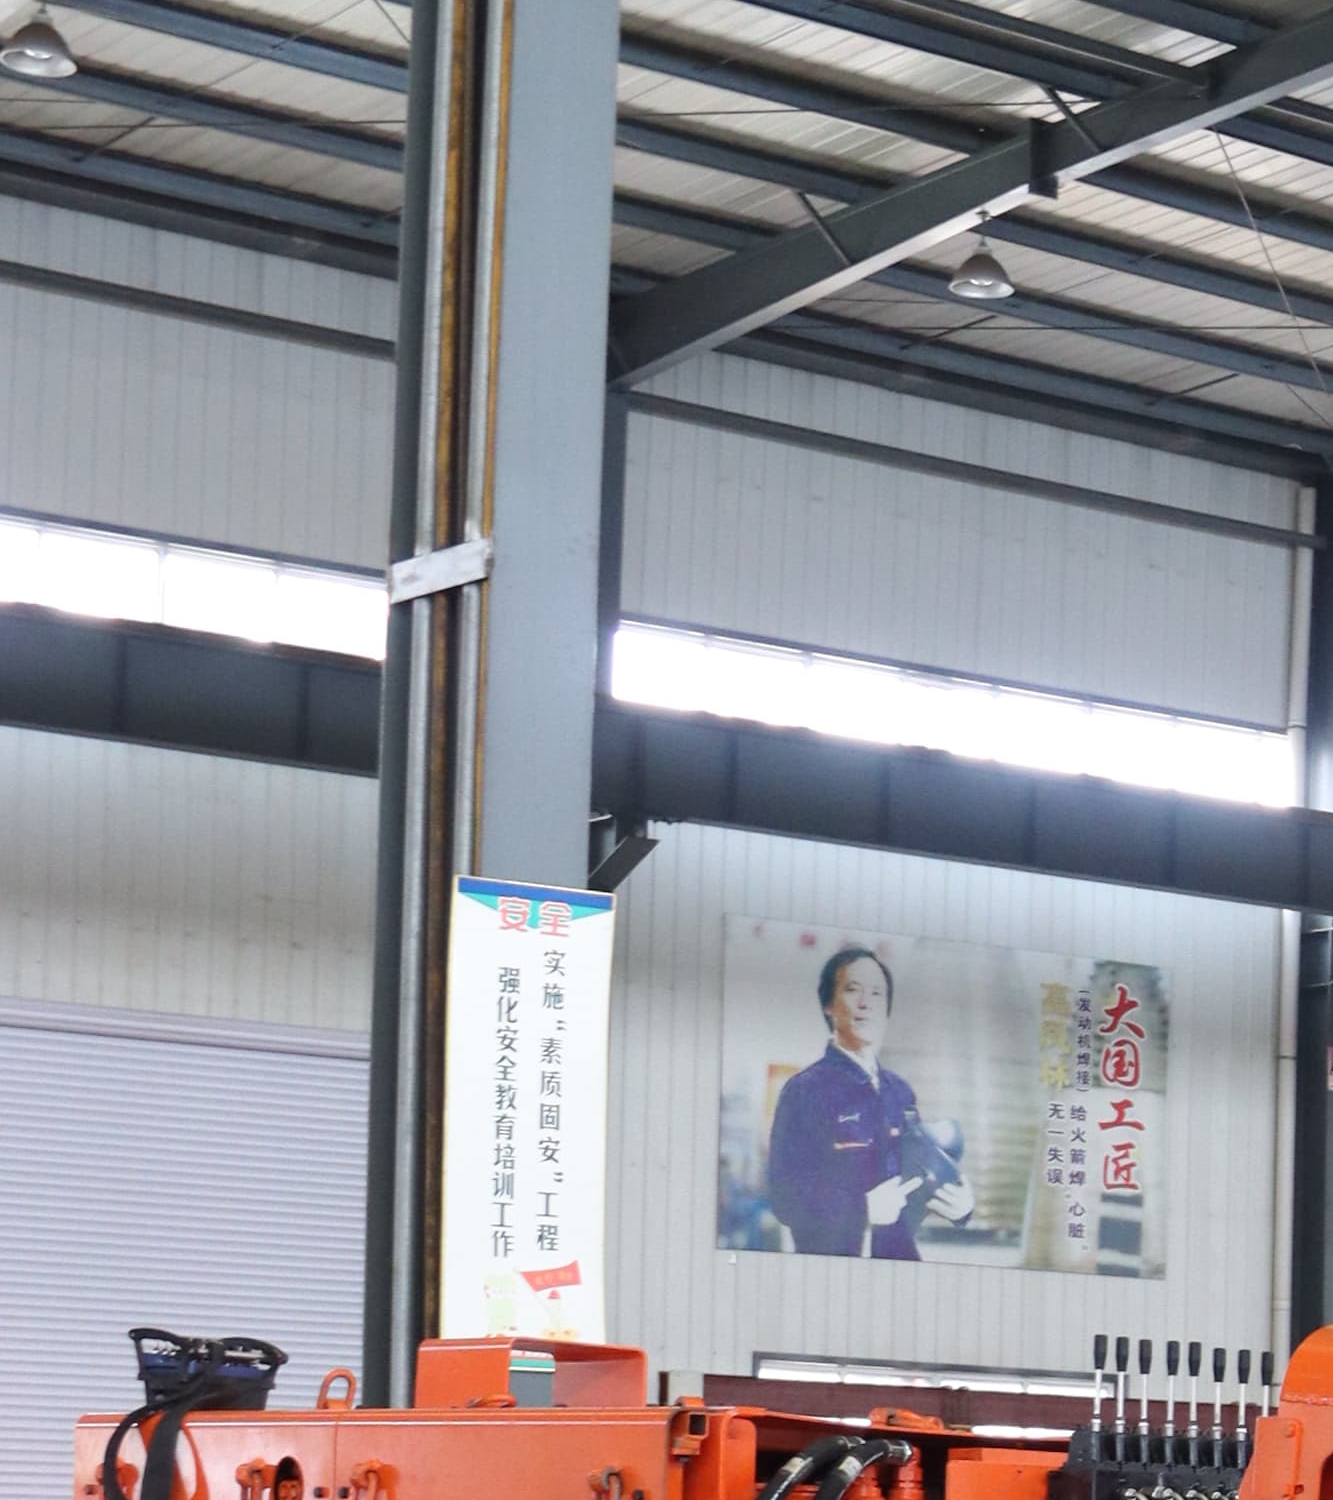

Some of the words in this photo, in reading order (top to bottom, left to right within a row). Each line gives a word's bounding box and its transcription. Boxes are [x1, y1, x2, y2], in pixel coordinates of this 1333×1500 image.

[497, 896, 572, 938] 安全
[492, 966, 521, 1258] 强化安全教育培训工作
[1047, 1102, 1065, 1186] 无一失误
[1098, 985, 1146, 1191] 大国工匠
